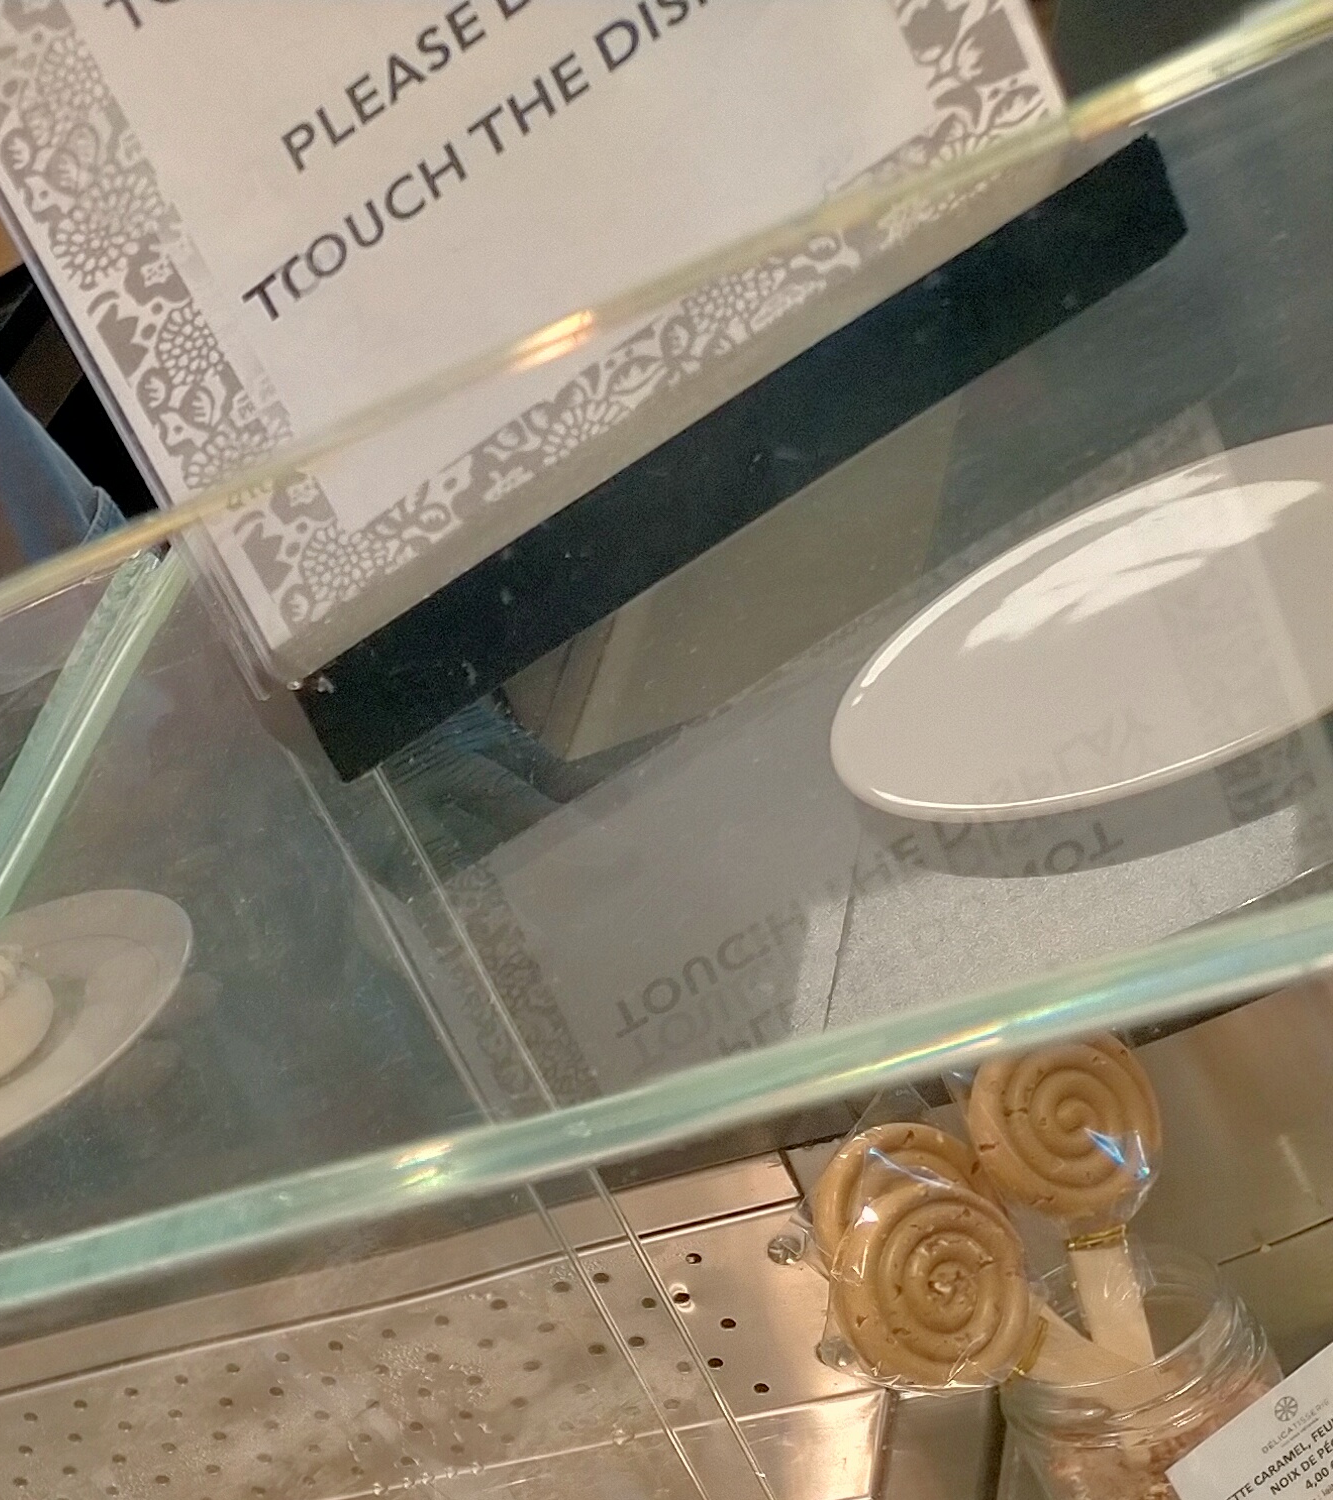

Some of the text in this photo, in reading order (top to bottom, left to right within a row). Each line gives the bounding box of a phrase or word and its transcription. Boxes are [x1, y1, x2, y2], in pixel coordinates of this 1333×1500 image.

[281, 1, 486, 172] PLEASE
[467, 53, 590, 155] THE
[594, 0, 707, 72] DIS
[1253, 1441, 1312, 1486] CARAMEL,
[1310, 1418, 1333, 1442] FEU
[1270, 1467, 1302, 1495] NOIX
[1300, 1454, 1318, 1472] DE
[1305, 1467, 1330, 1490] 4,00
